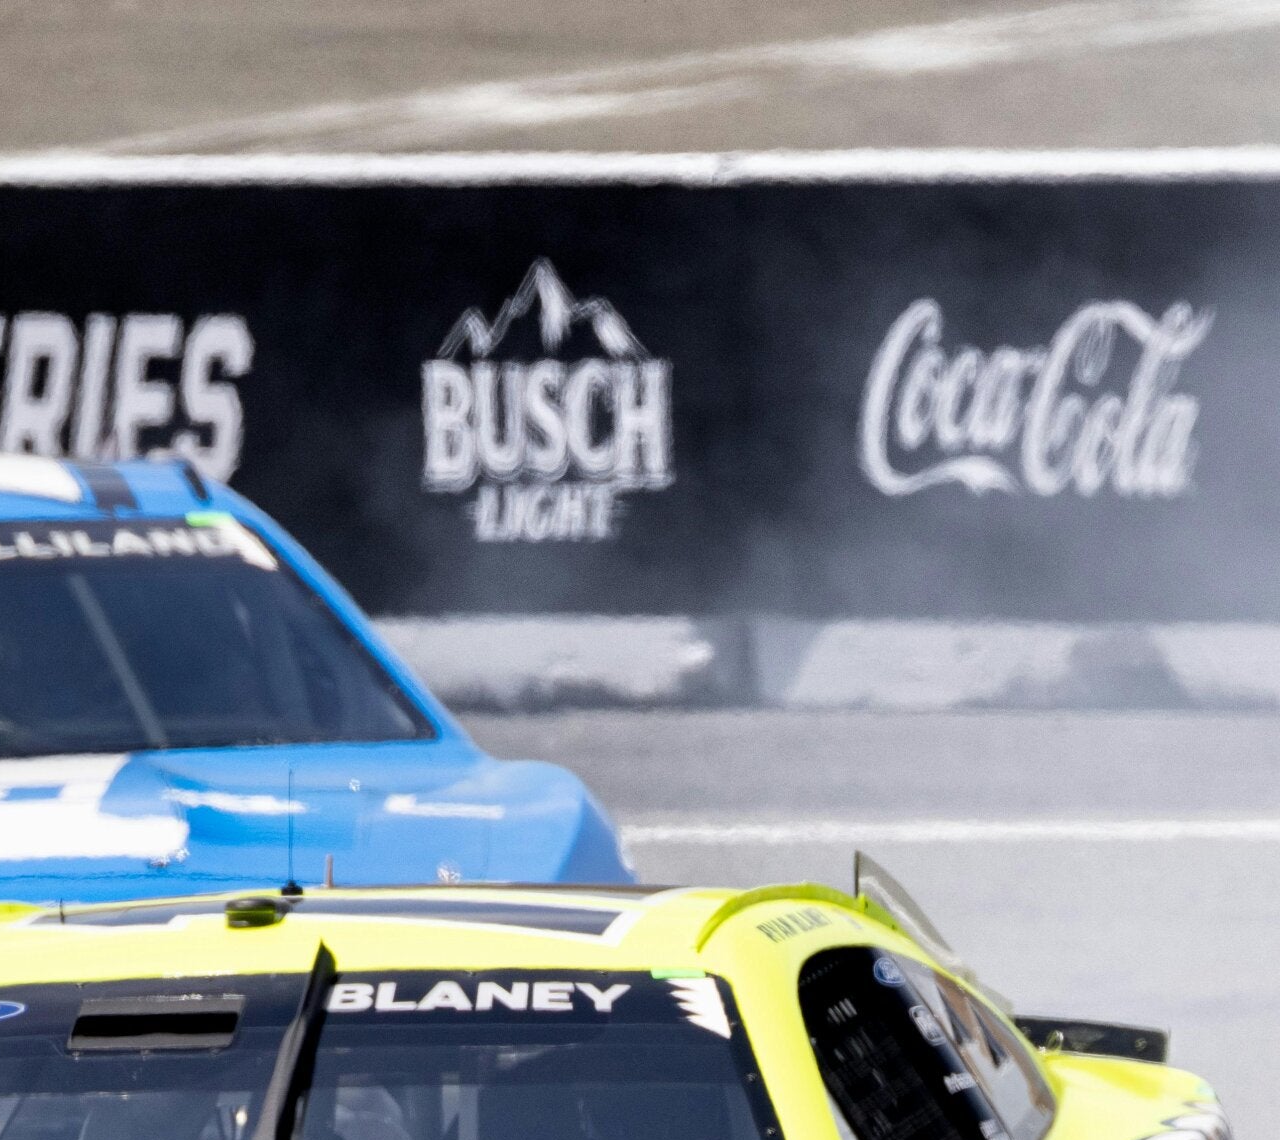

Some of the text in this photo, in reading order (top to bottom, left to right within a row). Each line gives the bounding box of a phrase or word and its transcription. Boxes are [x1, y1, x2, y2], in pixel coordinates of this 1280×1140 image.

[420, 358, 675, 492] BUSCH
[474, 484, 616, 542] LIGHT
[326, 980, 631, 1013] BLANEY
